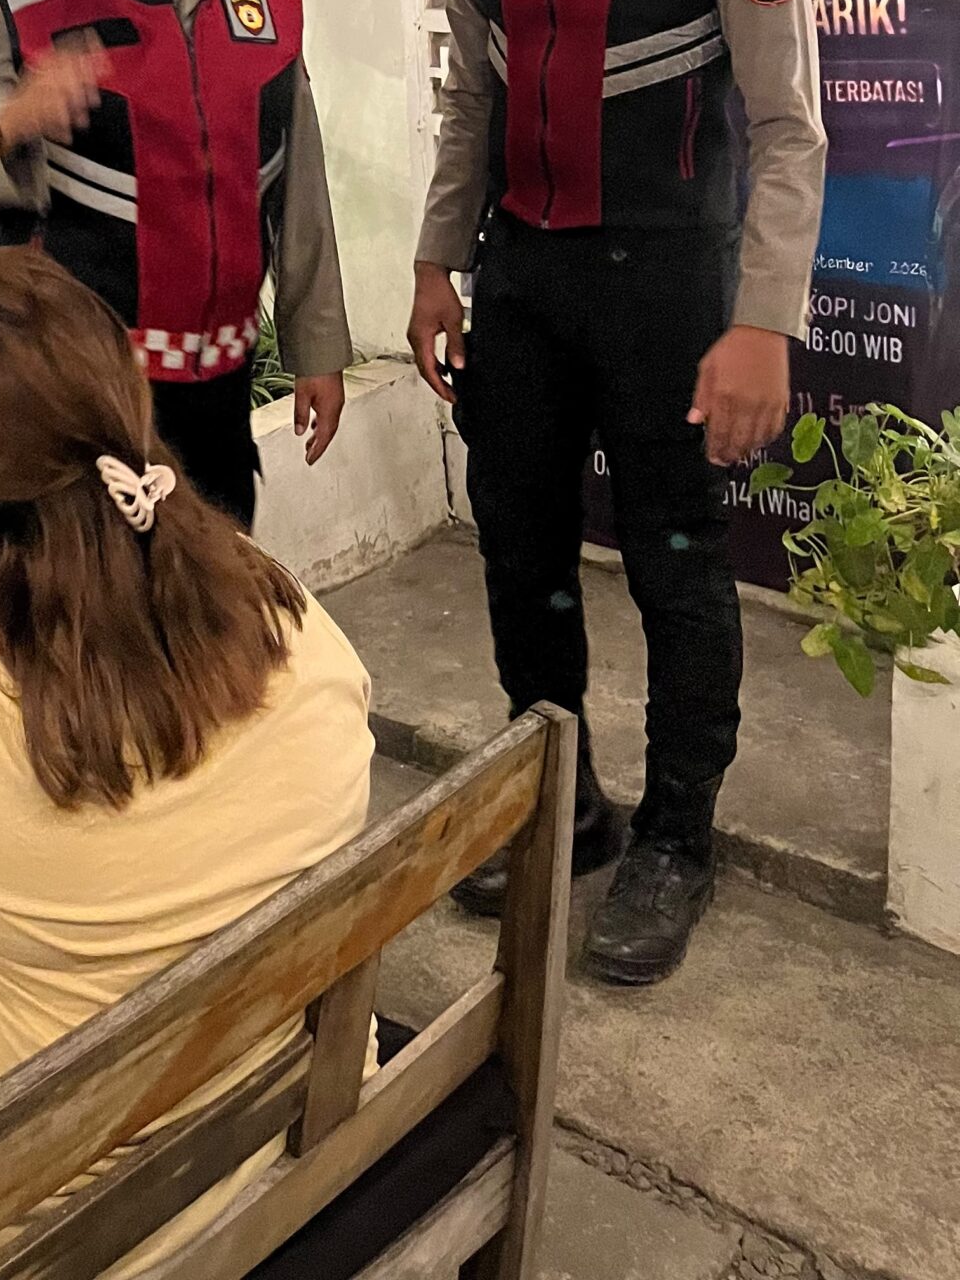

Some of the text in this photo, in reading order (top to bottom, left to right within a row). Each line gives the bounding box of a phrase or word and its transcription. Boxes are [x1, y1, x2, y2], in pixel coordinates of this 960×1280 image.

[823, 79, 925, 103] TERBATAS!
[863, 300, 916, 328] JONI
[805, 326, 903, 363] 16:00 WIB
